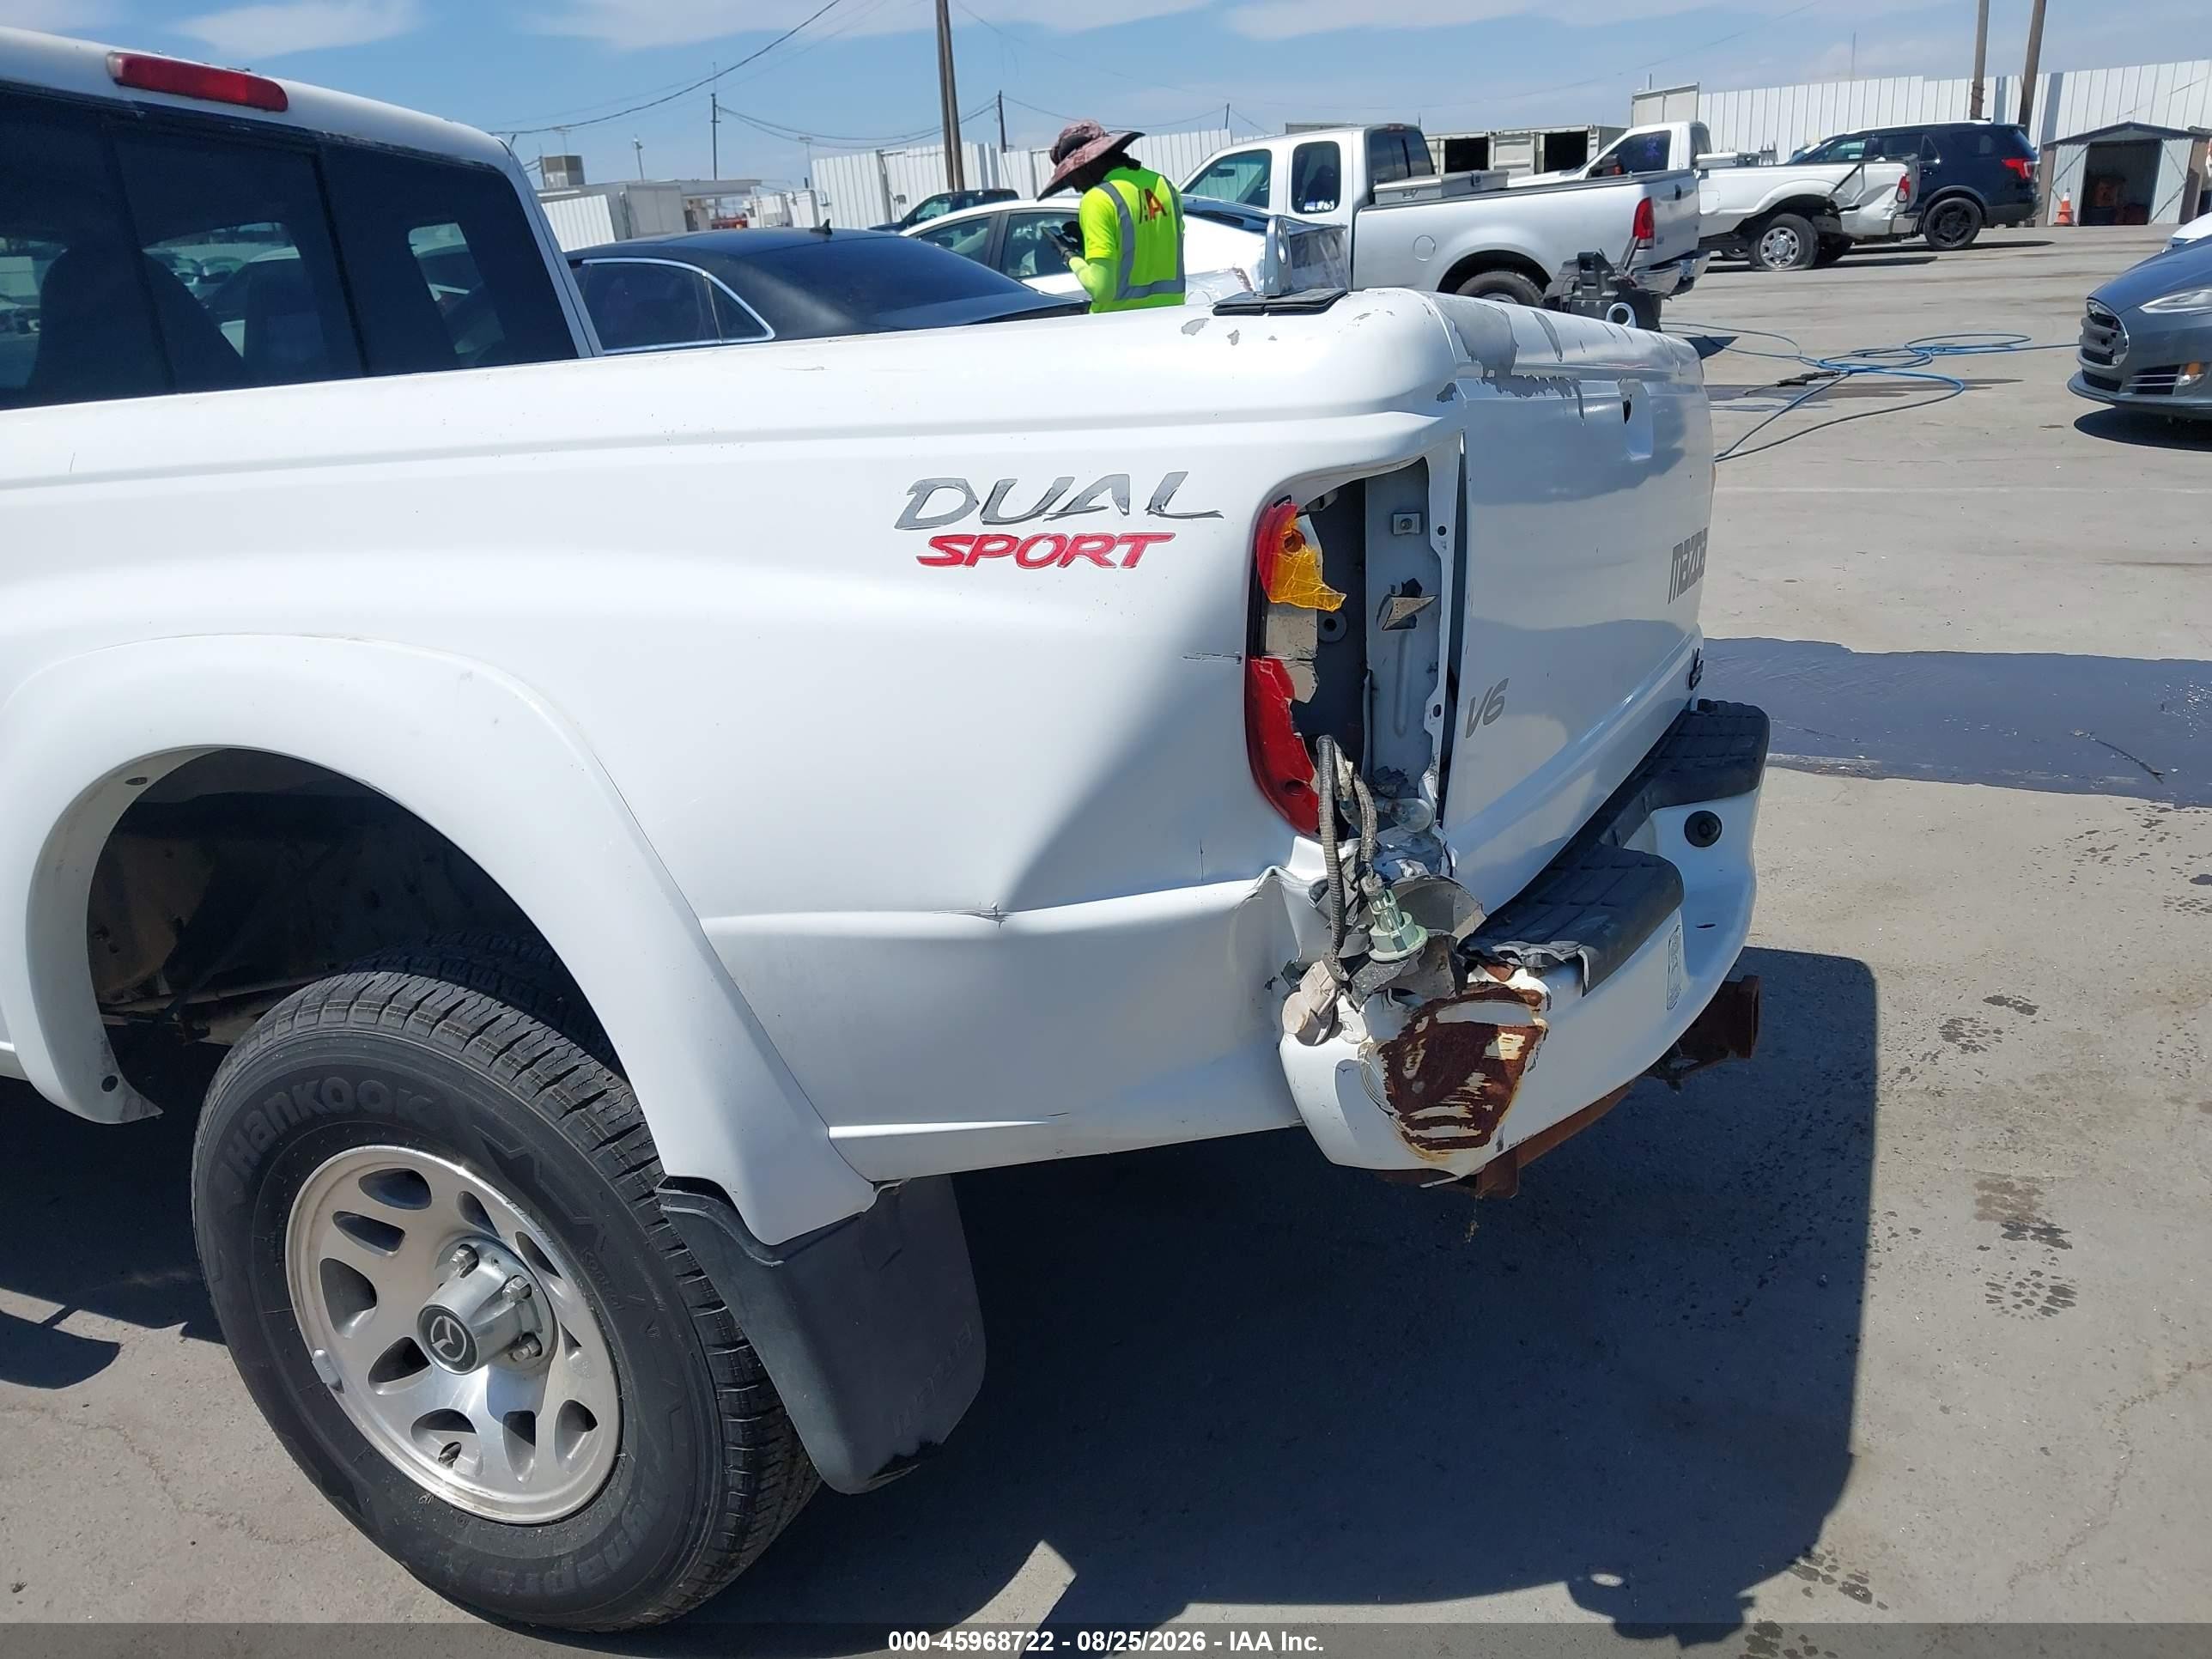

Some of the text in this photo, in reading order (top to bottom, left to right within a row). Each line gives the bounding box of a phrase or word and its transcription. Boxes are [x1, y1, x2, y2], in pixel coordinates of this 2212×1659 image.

[894, 471, 1224, 530] DUAL
[915, 532, 1176, 569] SPORT
[1466, 678, 1509, 738] V6
